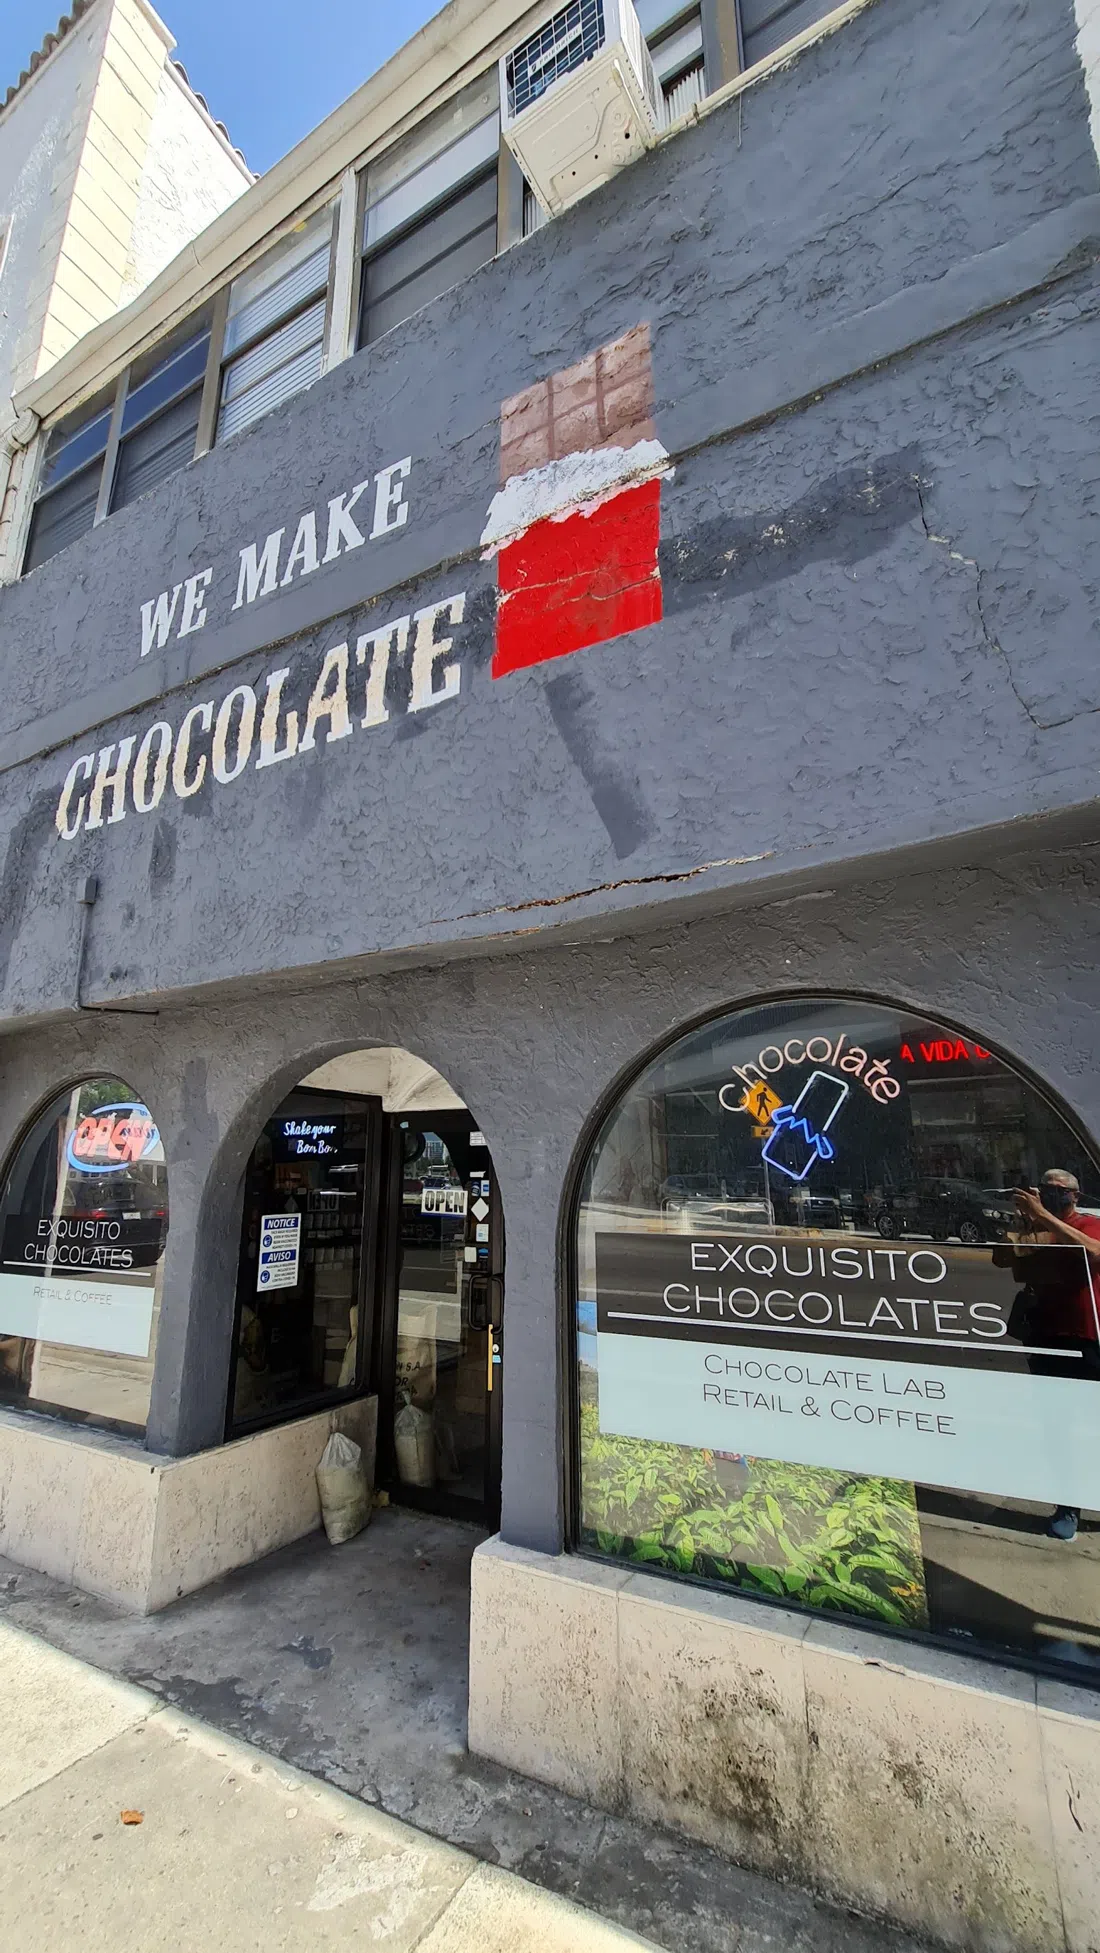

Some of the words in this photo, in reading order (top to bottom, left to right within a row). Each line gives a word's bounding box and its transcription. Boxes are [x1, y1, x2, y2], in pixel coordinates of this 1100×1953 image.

[139, 567, 213, 657] WE
[231, 456, 413, 611] MAKE
[55, 592, 466, 840] CHOCOLATE
[920, 1039, 969, 1063] VIDA
[73, 1116, 152, 1162] OPEN
[283, 1121, 312, 1136] Shake
[311, 1125, 337, 1140] your
[424, 1190, 466, 1213] OPEN
[37, 1219, 121, 1240] EXQUISITO
[266, 1218, 296, 1229] NOTICE
[24, 1243, 133, 1268] CHOCOLATES
[267, 1251, 292, 1263] AVISO
[690, 1242, 947, 1284] EXQUISITO
[33, 1286, 63, 1301] RETAIL
[64, 1289, 72, 1301] &
[73, 1290, 113, 1306] COFFEE
[663, 1283, 1008, 1338] CHOCOLATES
[703, 1354, 872, 1393] CHOCOLATE
[882, 1373, 946, 1400] LAB
[703, 1384, 793, 1415] RETAIL
[800, 1396, 821, 1418] &
[830, 1400, 957, 1436] COFFEE
